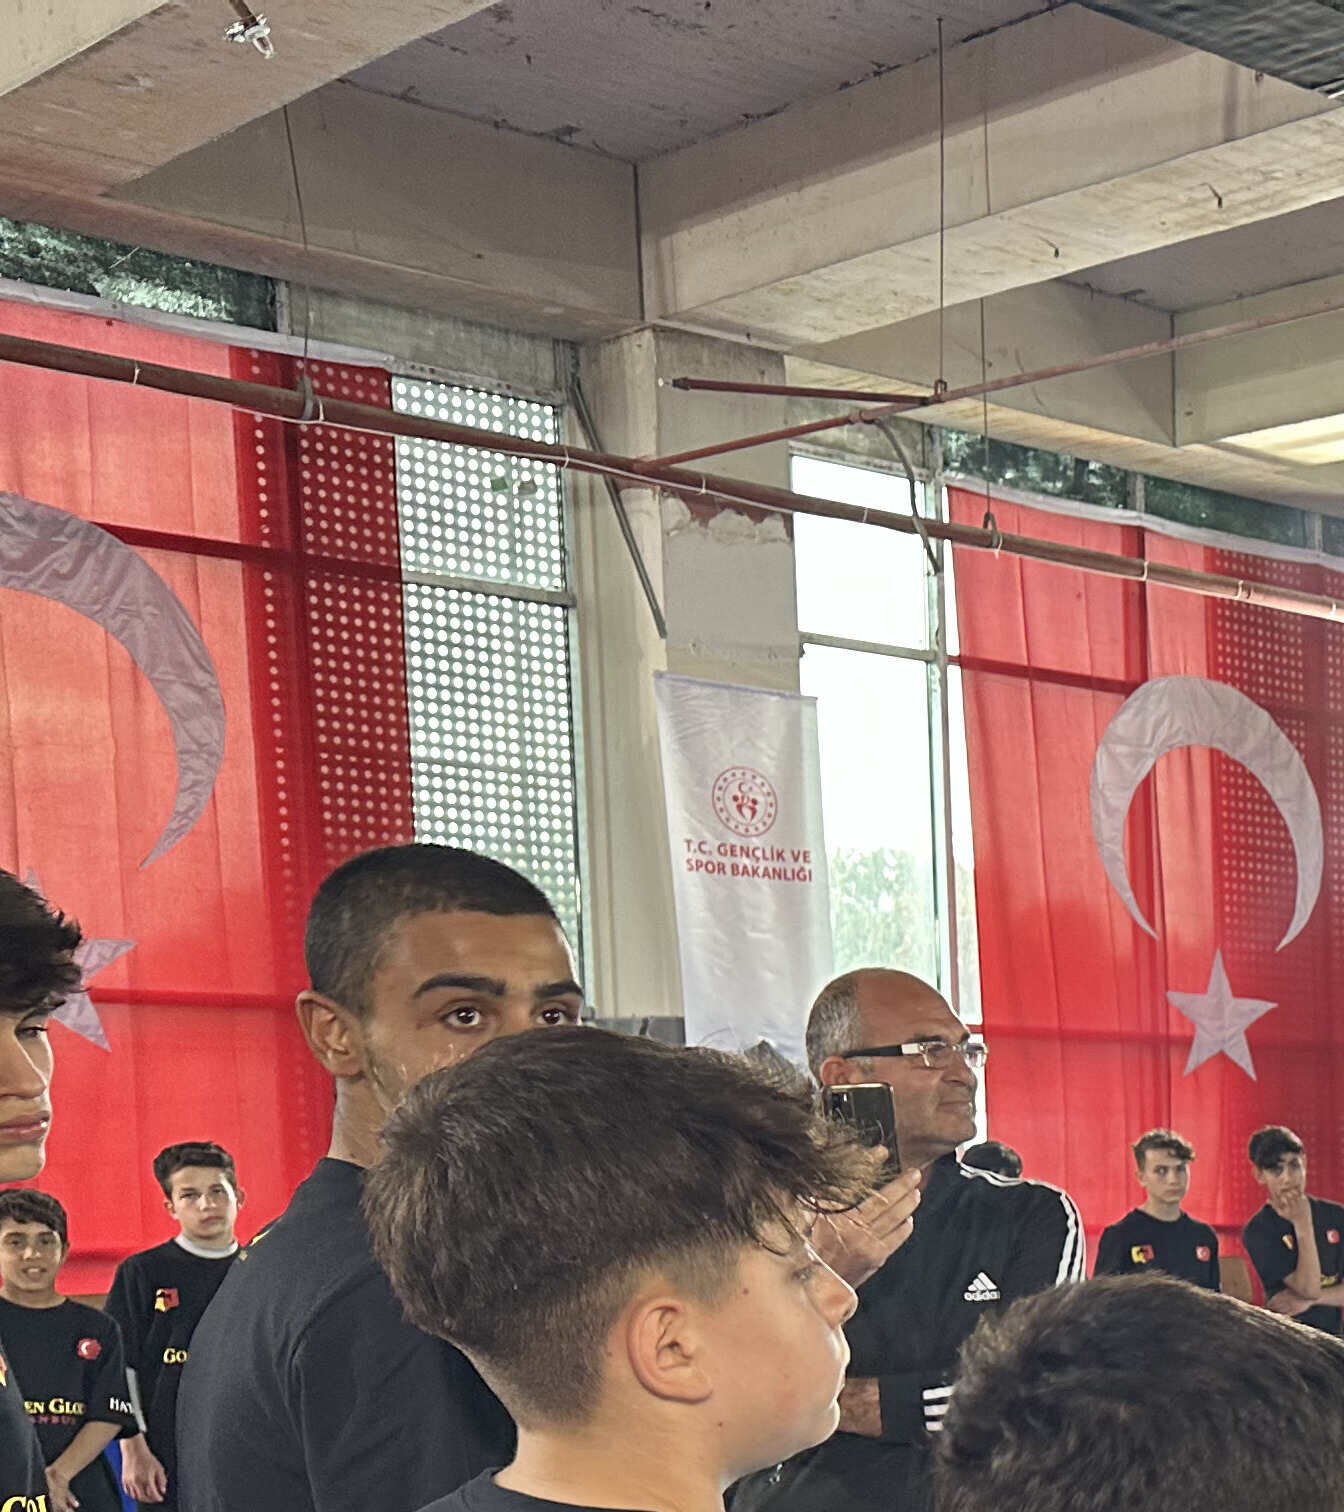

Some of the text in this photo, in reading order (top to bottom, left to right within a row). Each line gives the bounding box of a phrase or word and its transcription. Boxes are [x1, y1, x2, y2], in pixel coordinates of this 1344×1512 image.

[684, 839, 811, 864] T.C. GENÇLİK VE
[686, 858, 812, 882] SPOR BAKANLIĞI
